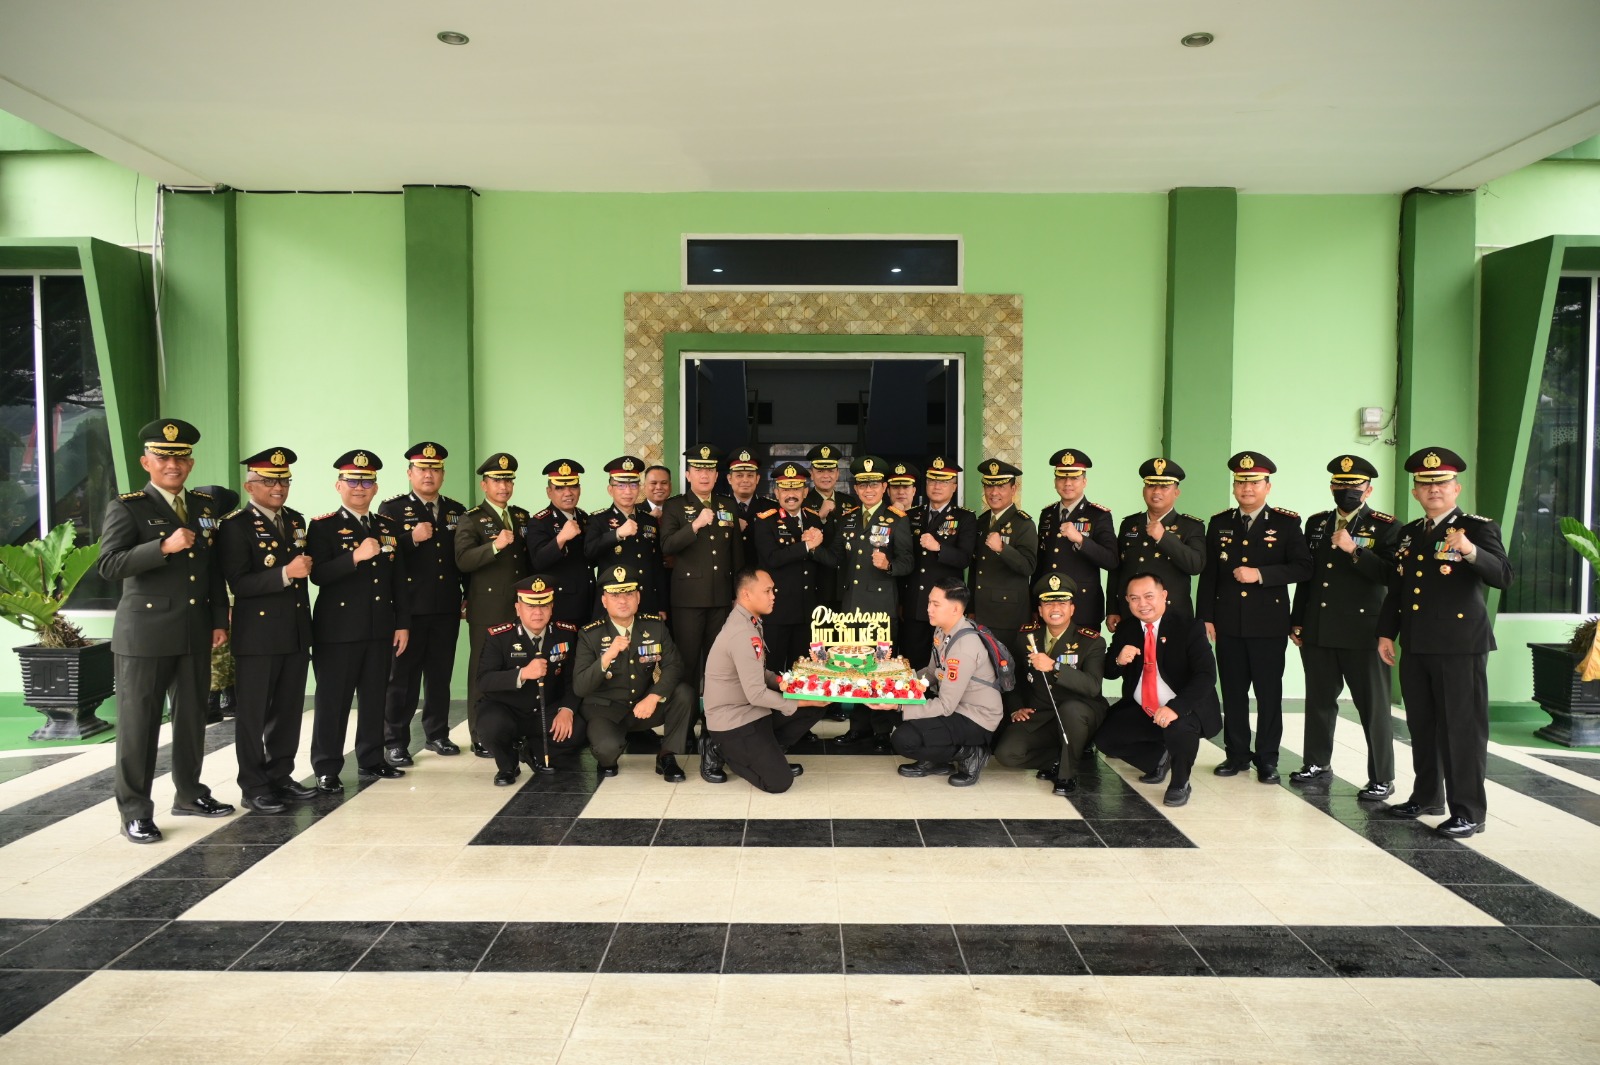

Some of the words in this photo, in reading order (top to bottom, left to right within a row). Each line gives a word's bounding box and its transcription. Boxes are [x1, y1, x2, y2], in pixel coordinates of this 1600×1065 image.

[811, 605, 890, 631] Dirgahayu
[812, 628, 834, 642] HUT
[838, 628, 856, 642] TNI
[859, 628, 874, 642] KE
